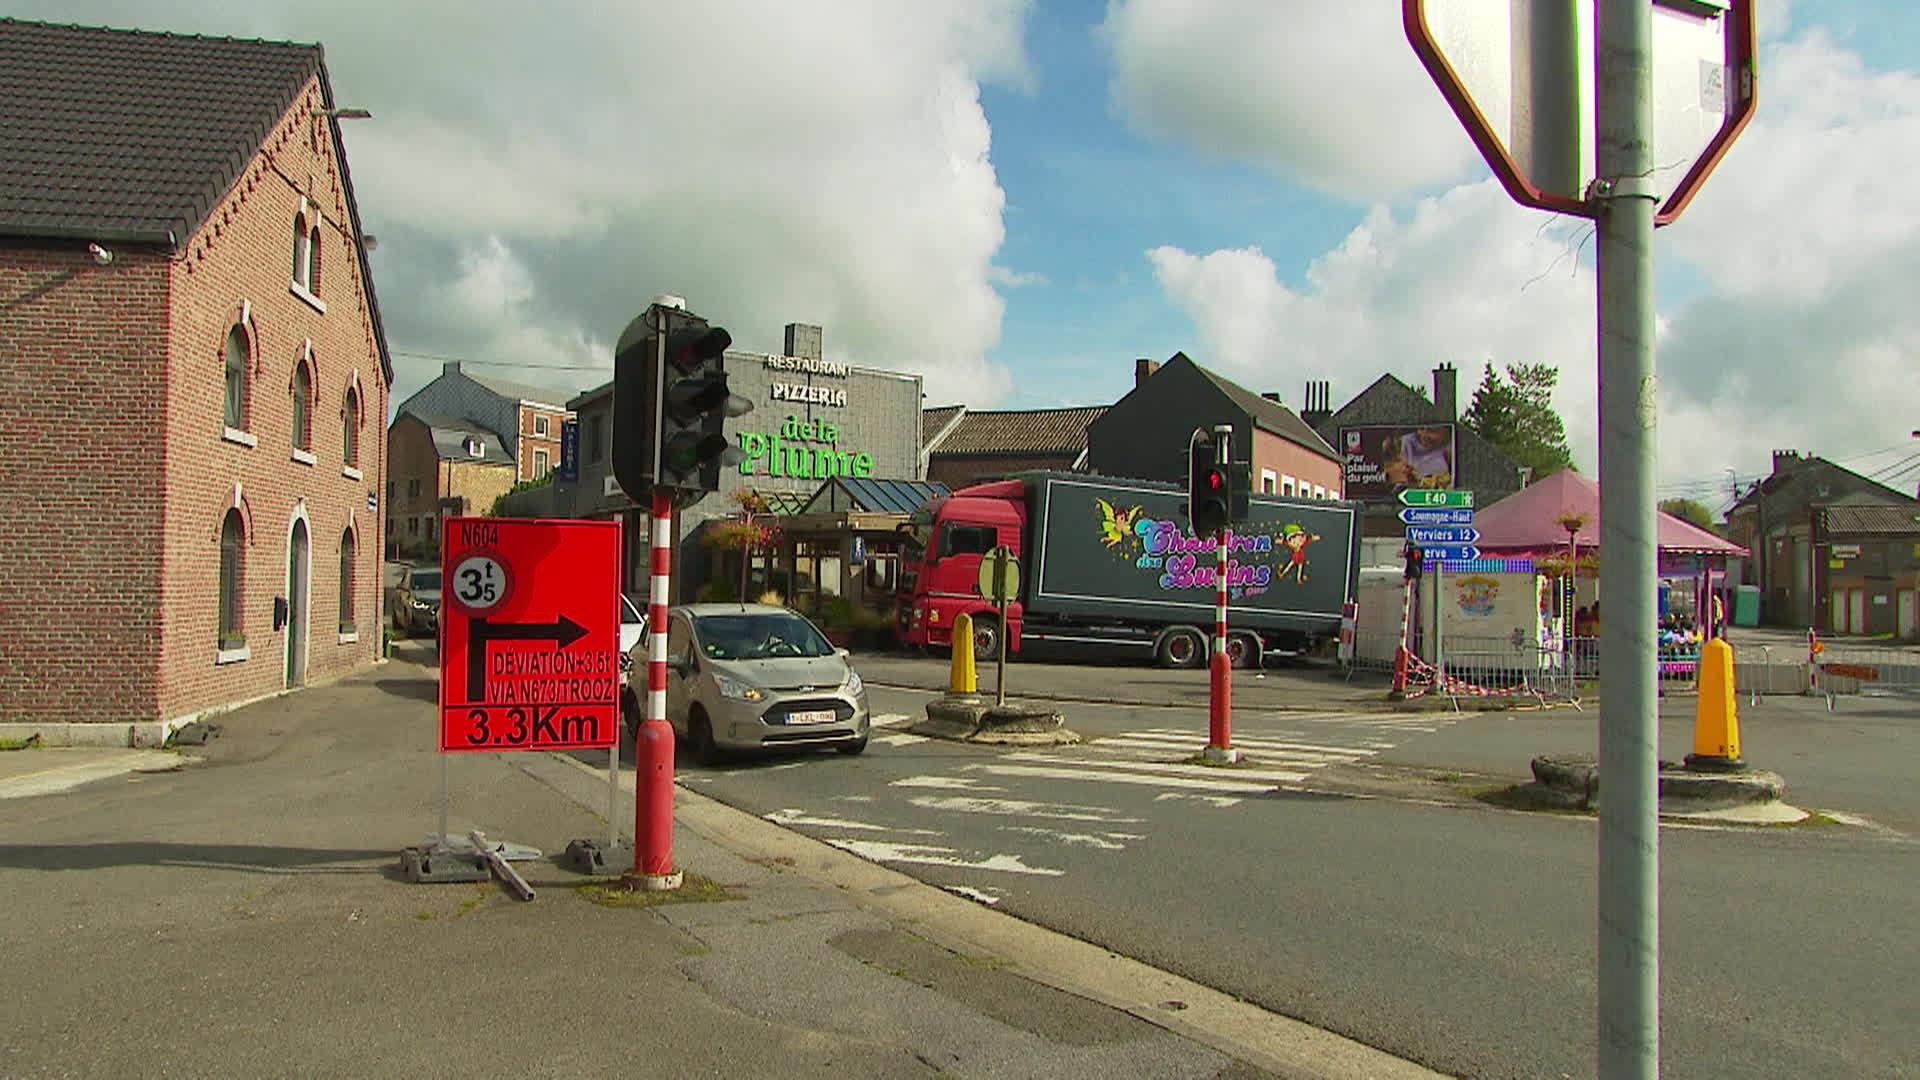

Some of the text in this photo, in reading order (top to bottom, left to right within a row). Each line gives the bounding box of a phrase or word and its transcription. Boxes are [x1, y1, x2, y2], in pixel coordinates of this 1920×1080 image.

[772, 382, 847, 406] PIZZERIA
[783, 415, 840, 443] de la
[739, 431, 875, 479] Plume
[1347, 461, 1378, 474] plaisir
[1347, 473, 1360, 482] du
[460, 524, 498, 545] N604
[1411, 528, 1471, 540] Verviers 12
[1424, 546, 1469, 559] erve 5
[490, 680, 515, 702] VIA
